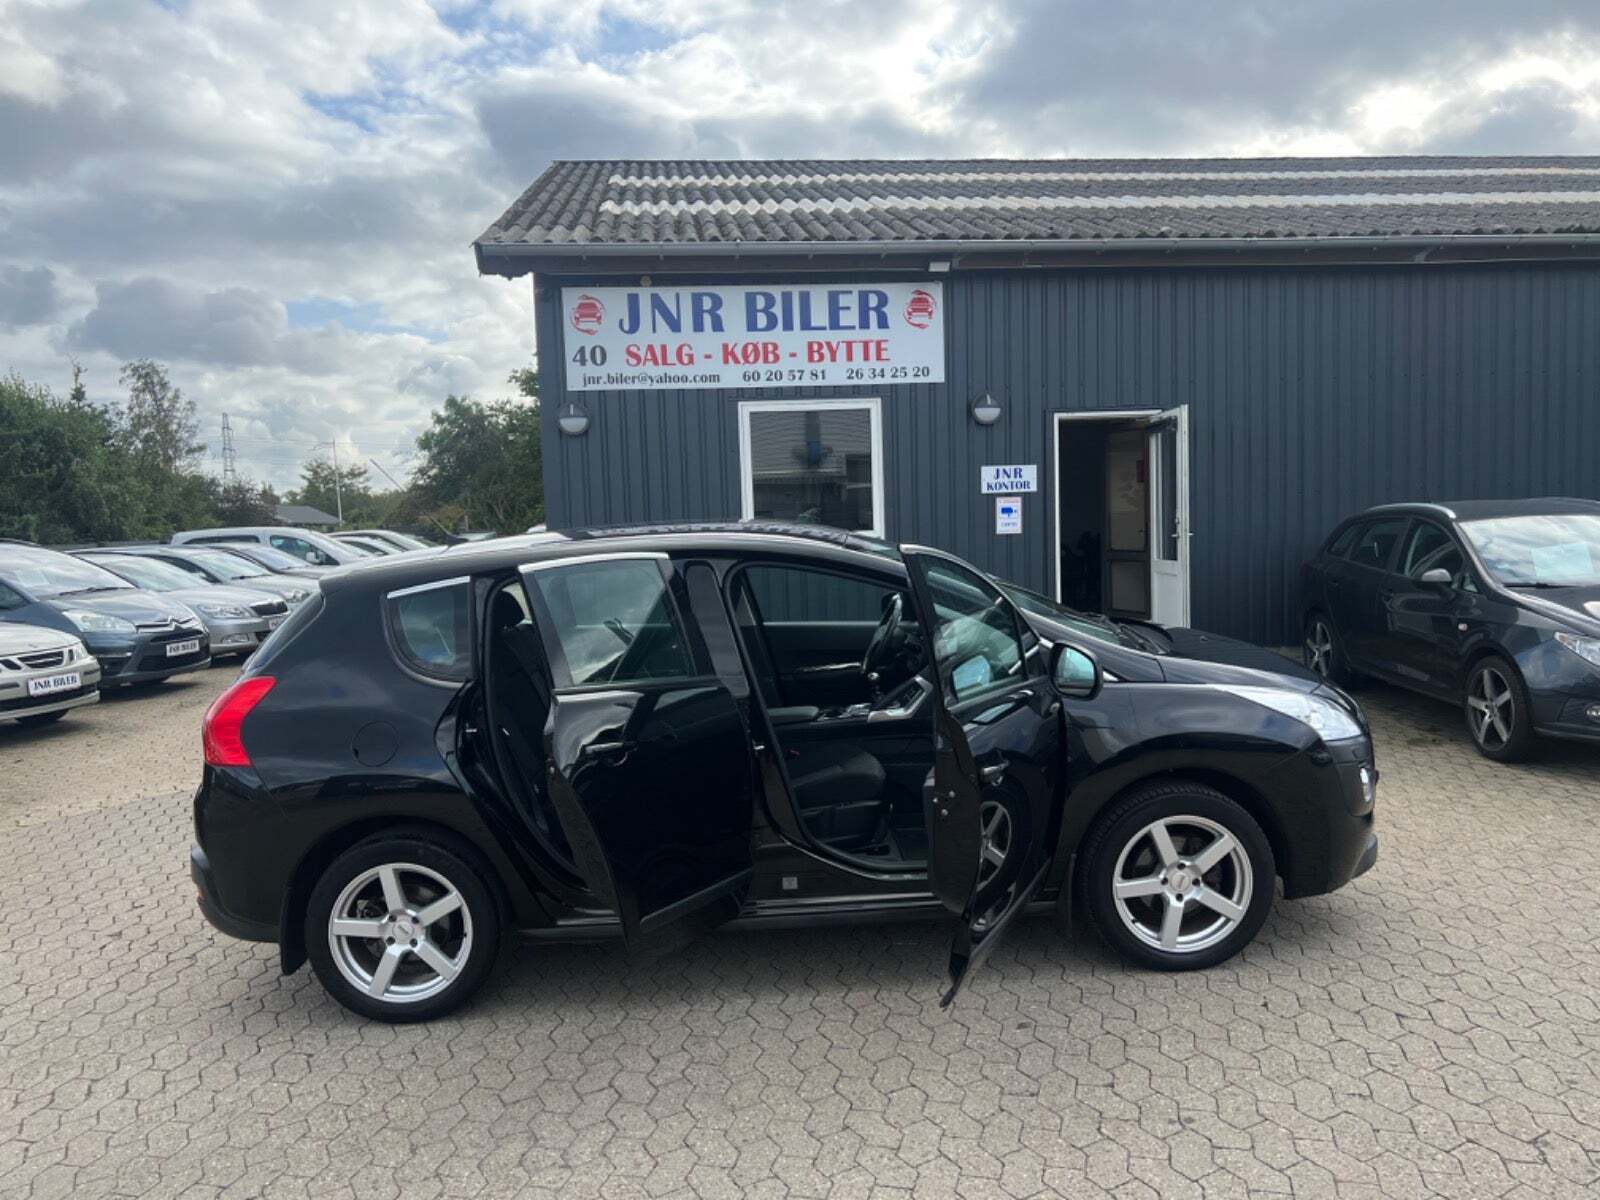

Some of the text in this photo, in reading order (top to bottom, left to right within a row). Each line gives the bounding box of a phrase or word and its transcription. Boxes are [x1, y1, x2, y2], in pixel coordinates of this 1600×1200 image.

[618, 290, 890, 334] JNR BILER
[572, 345, 606, 366] 40
[625, 344, 695, 366] SALG
[722, 341, 780, 365] KØB
[807, 339, 890, 363] BYTTE
[583, 372, 720, 387] jnr.biler@yahoo.com
[743, 369, 826, 382] 60 20 57 81
[846, 366, 930, 380] 26 34 25 20
[994, 467, 1023, 479] JNR
[986, 480, 1031, 491] KONTOR
